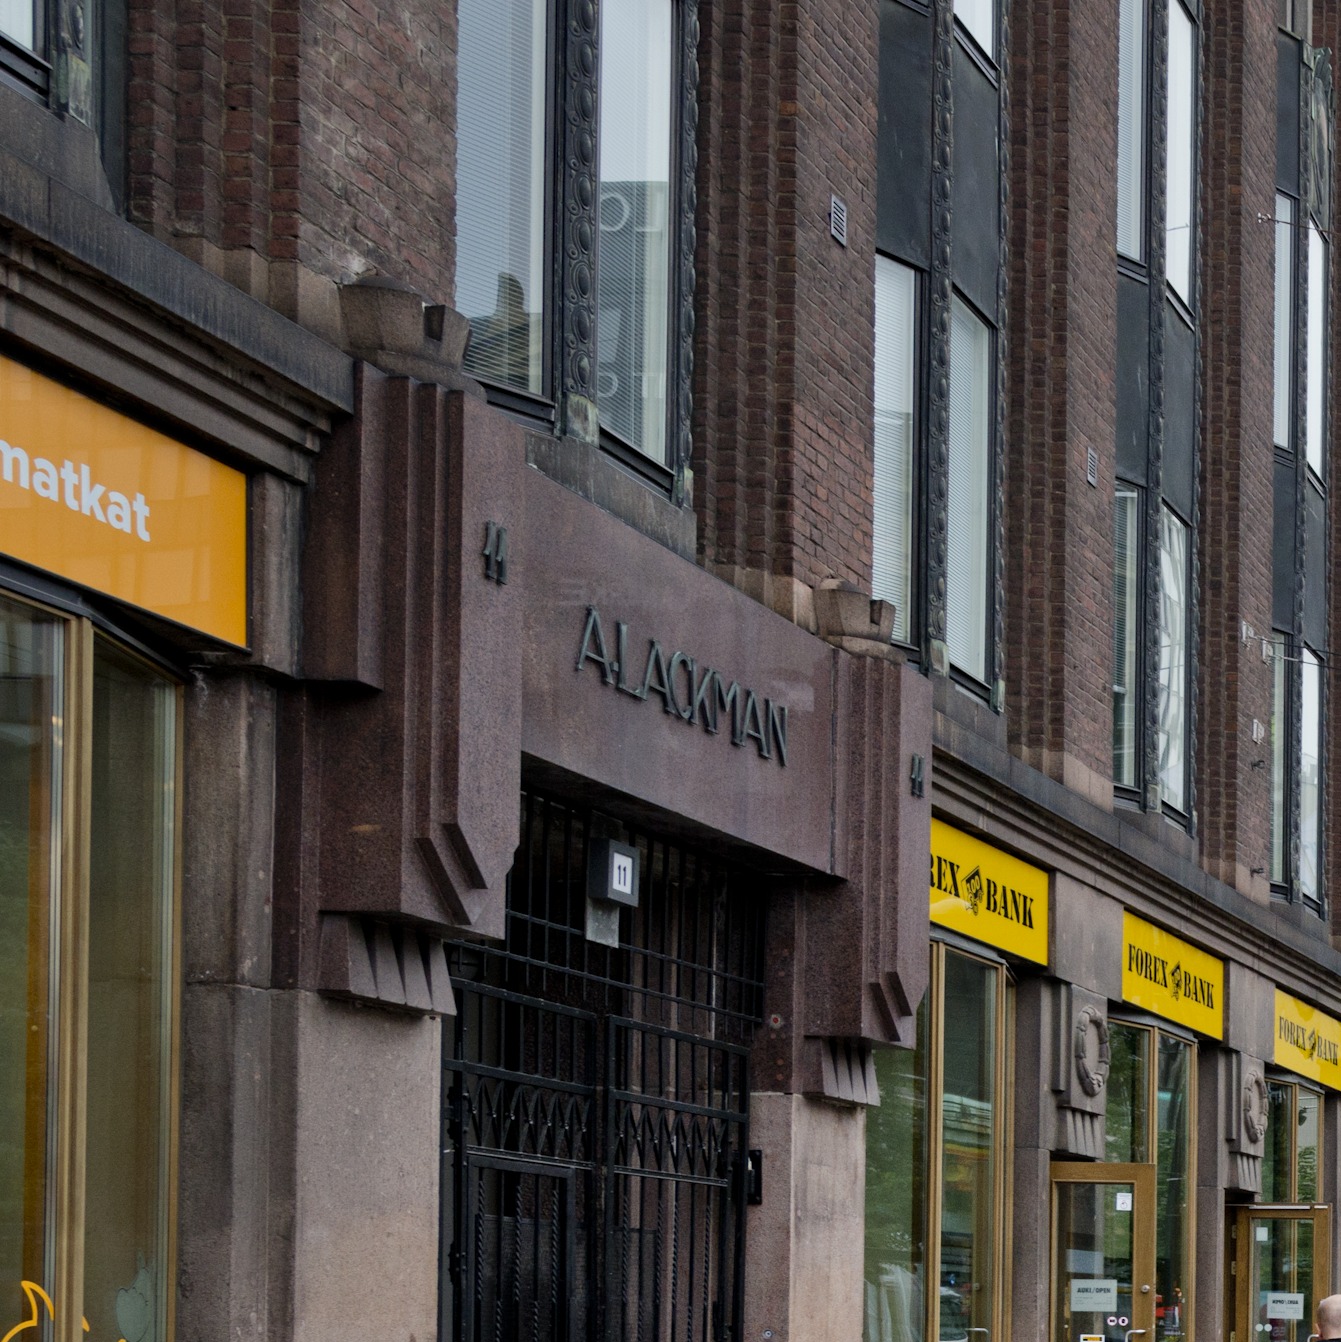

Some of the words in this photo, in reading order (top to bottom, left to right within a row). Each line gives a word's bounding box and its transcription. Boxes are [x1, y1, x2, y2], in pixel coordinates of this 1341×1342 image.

[483, 520, 508, 586] 11
[617, 865, 627, 887] 11
[985, 878, 1035, 930] BANK
[1127, 943, 1169, 989] FOREX
[1183, 969, 1215, 1010] BANK
[1278, 1016, 1307, 1051] FOREX
[1316, 1032, 1339, 1066] BANK
